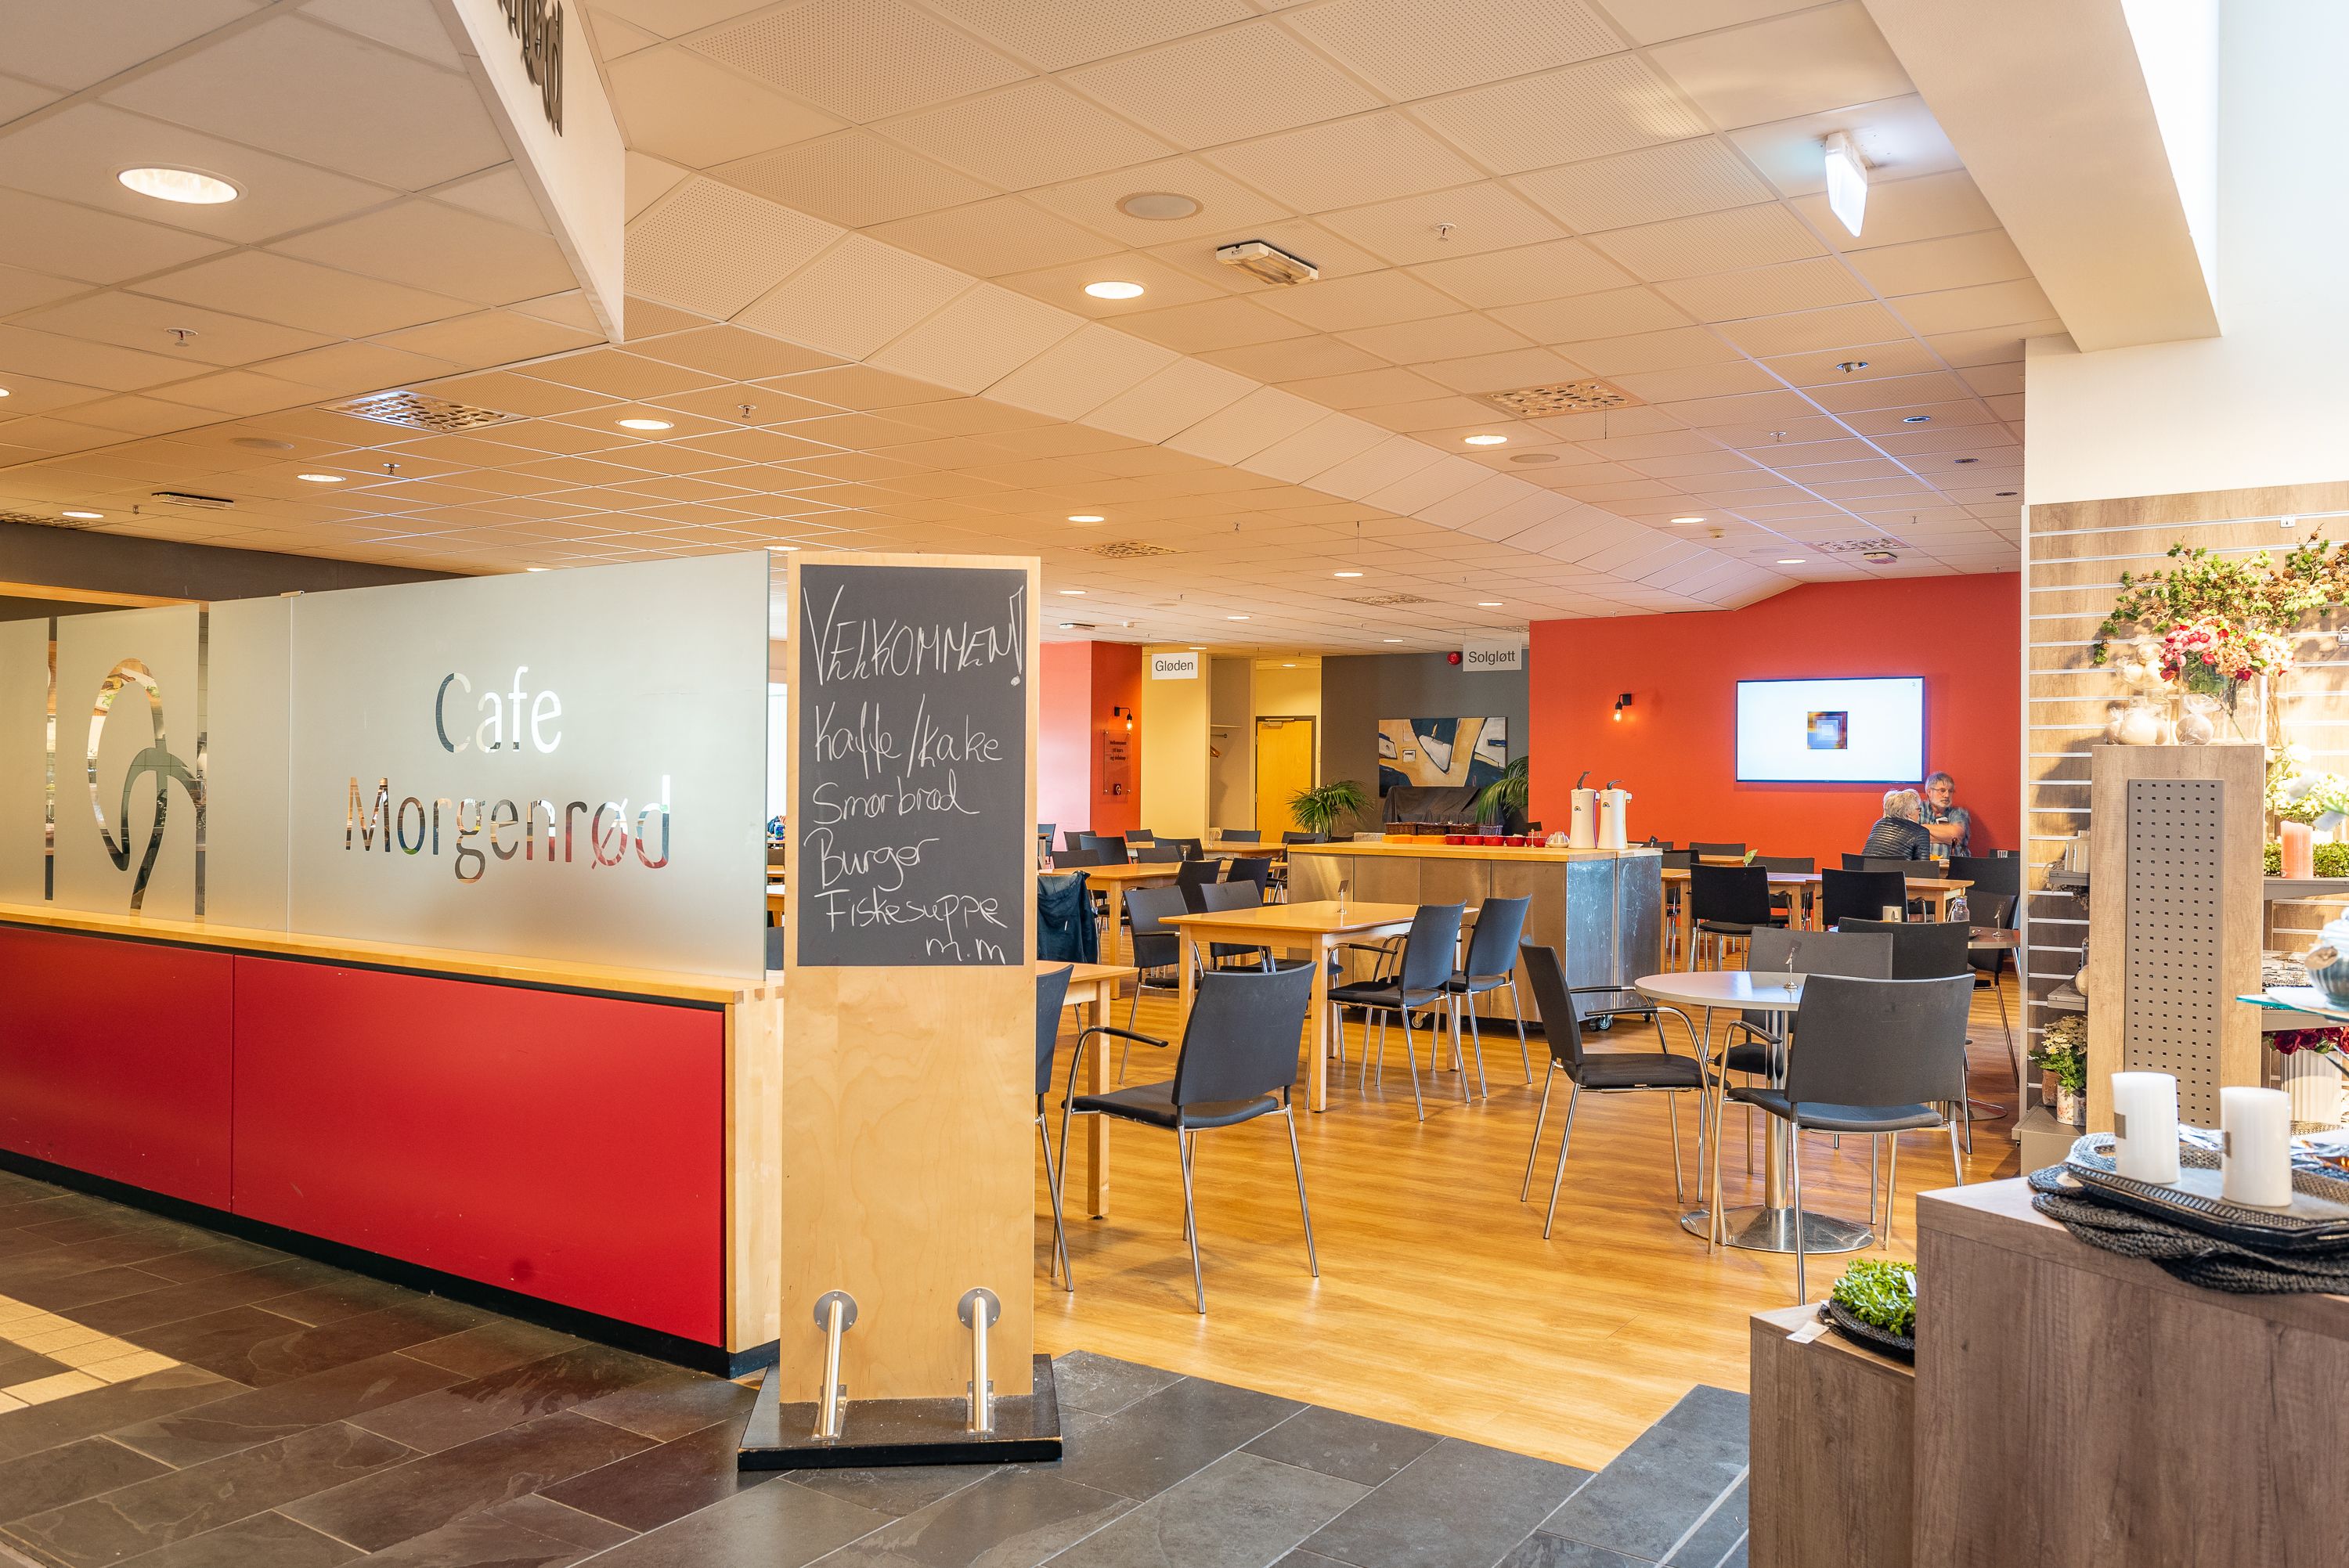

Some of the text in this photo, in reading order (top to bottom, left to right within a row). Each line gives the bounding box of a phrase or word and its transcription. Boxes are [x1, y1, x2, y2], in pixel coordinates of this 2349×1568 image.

[1155, 660, 1194, 672] Gløden
[1468, 651, 1516, 665] Solgløtt
[435, 665, 562, 754] Cafe
[345, 774, 672, 885] Morgenrød
[803, 827, 940, 892] Burger
[814, 887, 1009, 943] Fiskesuppe
